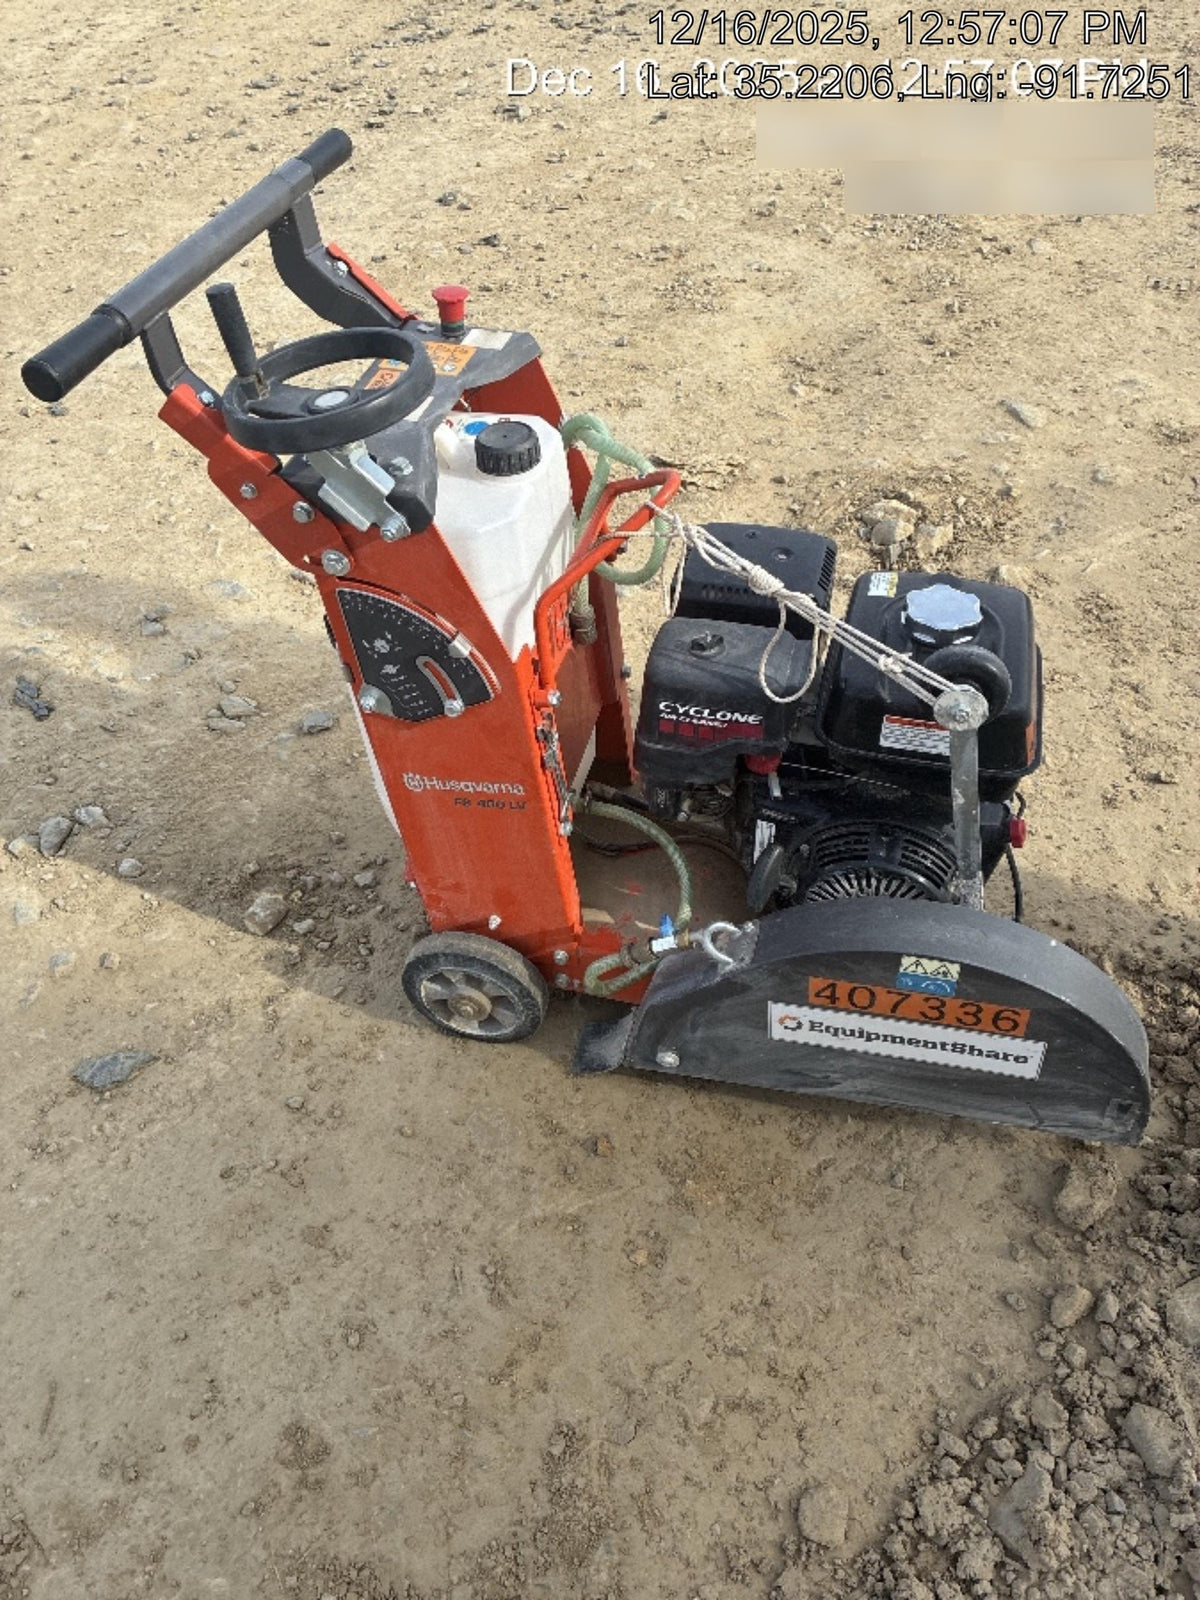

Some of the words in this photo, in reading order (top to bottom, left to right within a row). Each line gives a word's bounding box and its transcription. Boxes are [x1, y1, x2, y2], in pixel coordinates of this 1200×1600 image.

[659, 701, 763, 725] CYCLONE
[422, 776, 525, 796] Husqvarna
[813, 981, 1022, 1034] 407336
[808, 1019, 1029, 1065] EquipmentShare
